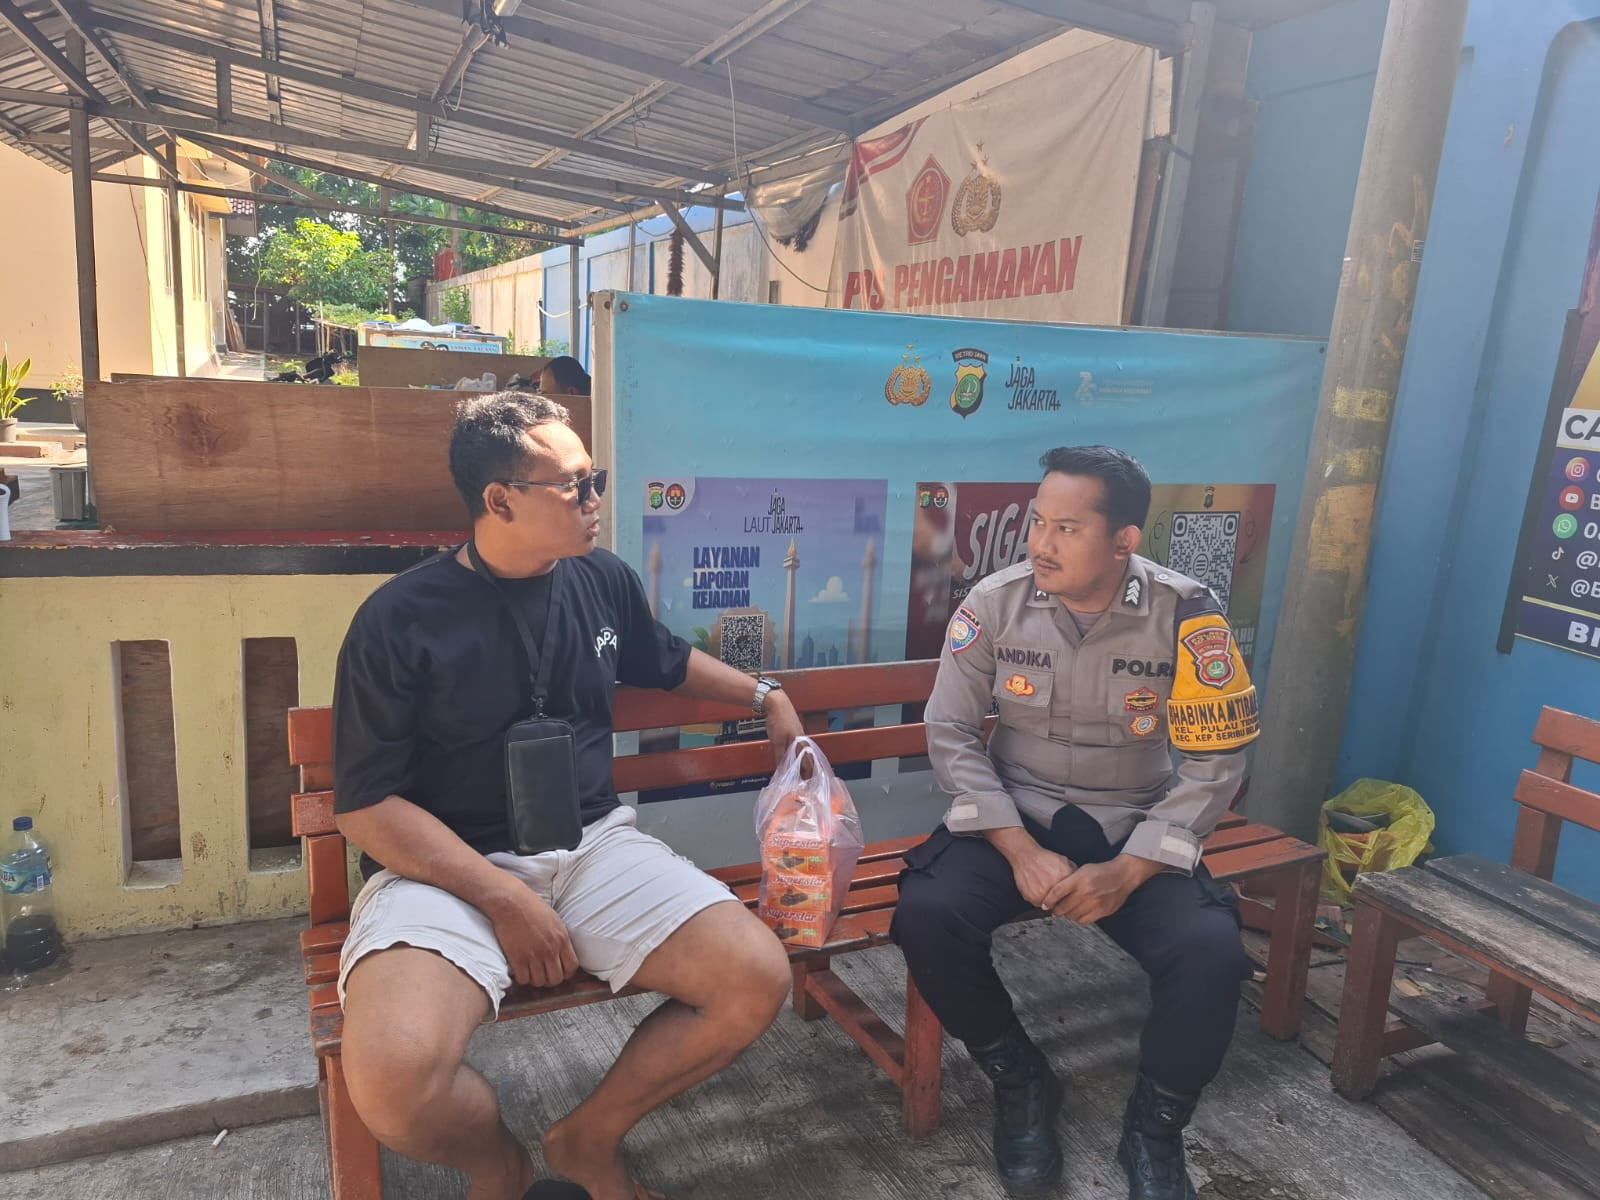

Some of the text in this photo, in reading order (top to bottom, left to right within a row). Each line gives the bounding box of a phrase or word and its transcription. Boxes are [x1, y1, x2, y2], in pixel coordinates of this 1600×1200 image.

[894, 236, 1083, 308] PENGAMANAN
[1005, 364, 1035, 388] JAGA
[768, 495, 785, 515] JAGA
[744, 516, 771, 533] LAUT
[693, 546, 760, 568] LAYANAN
[693, 570, 749, 590] LAPORAN
[692, 589, 750, 609] KEJADIAN
[997, 647, 1052, 669] ANDIKA
[1201, 721, 1238, 733] PULAU
[1216, 729, 1244, 740] SERIBU
